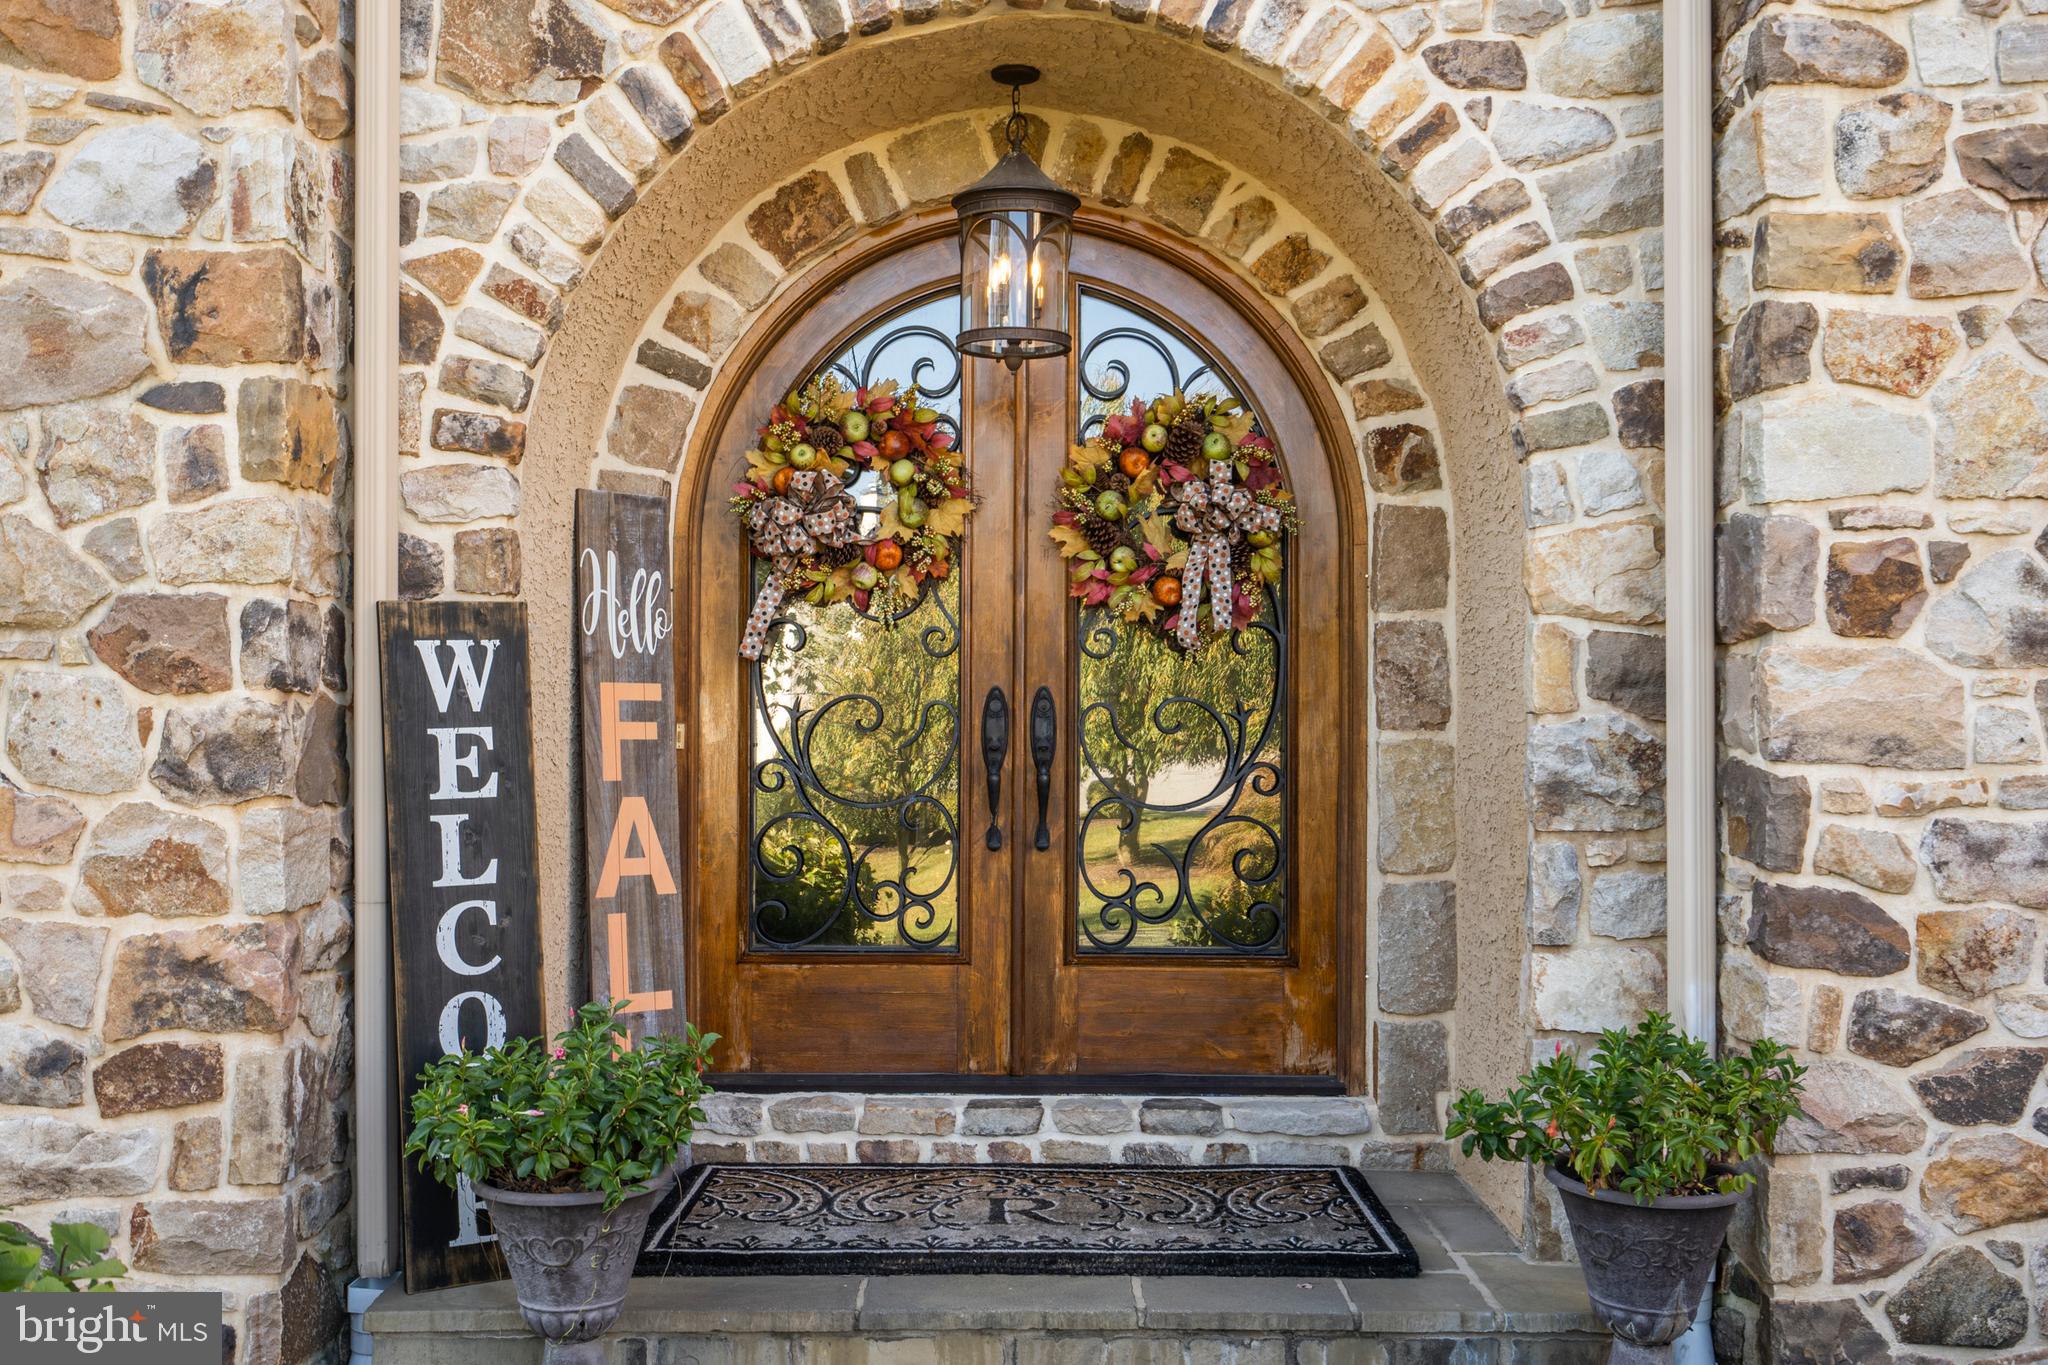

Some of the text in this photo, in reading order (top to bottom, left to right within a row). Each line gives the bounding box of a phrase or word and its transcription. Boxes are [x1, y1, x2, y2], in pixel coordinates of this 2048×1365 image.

[580, 547, 673, 659] Hello
[414, 638, 506, 1247] WELCO
[595, 681, 677, 1062] FAL
[986, 1197, 1074, 1225] R
